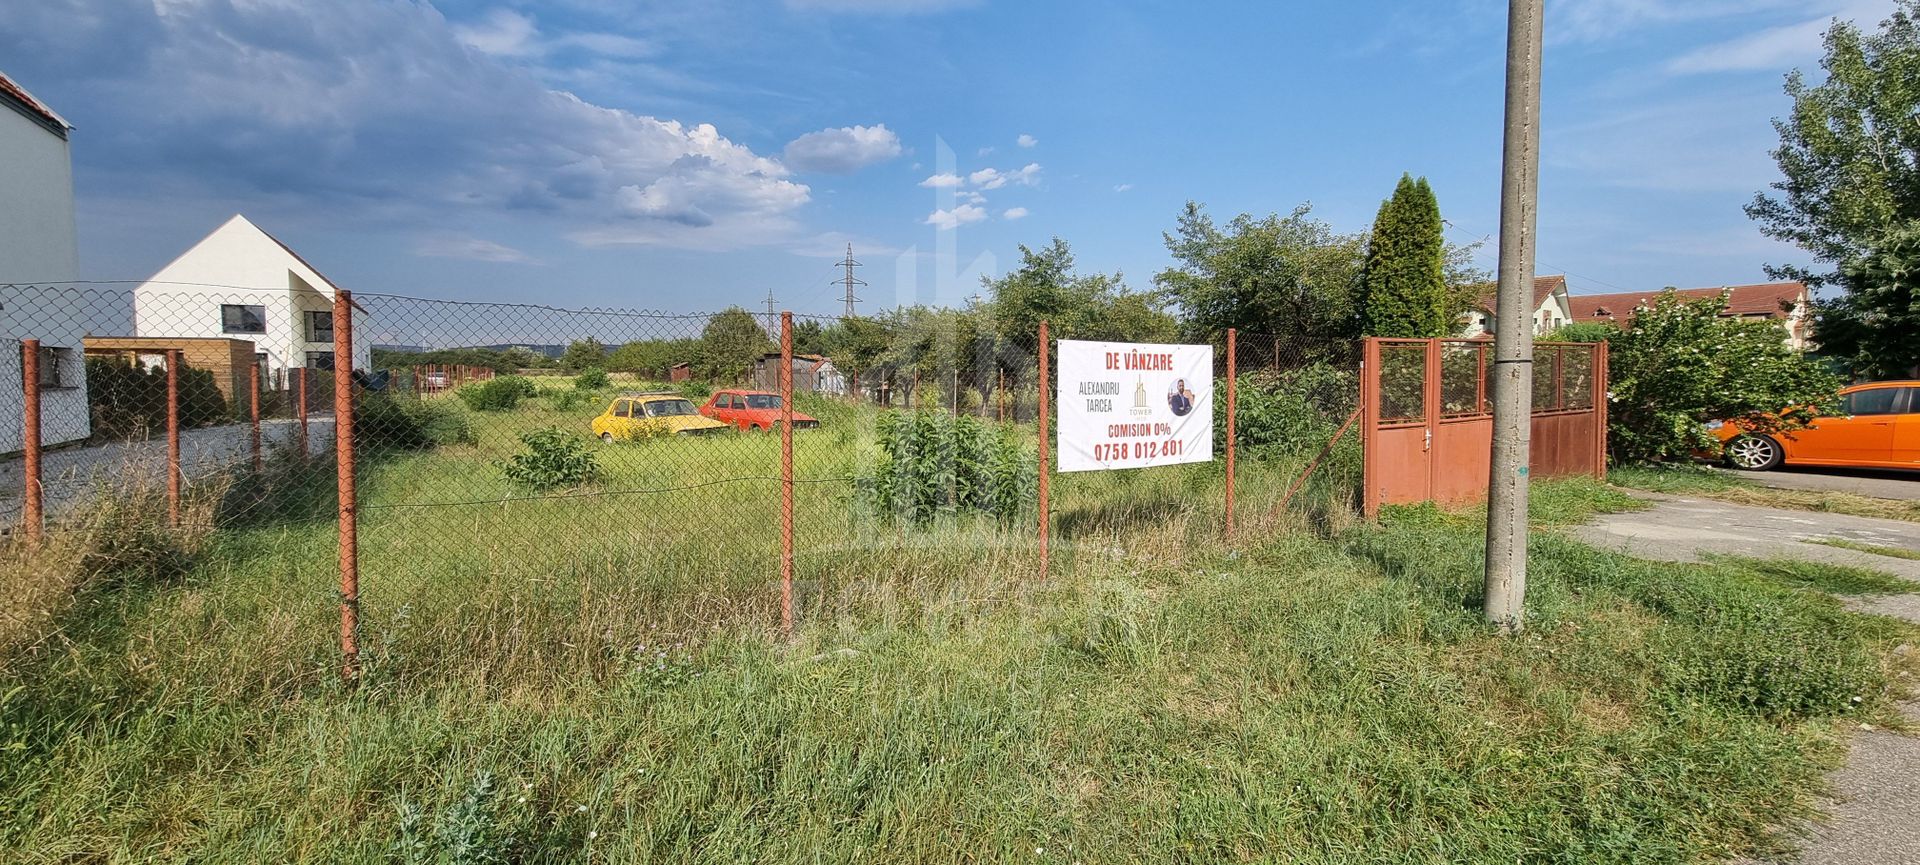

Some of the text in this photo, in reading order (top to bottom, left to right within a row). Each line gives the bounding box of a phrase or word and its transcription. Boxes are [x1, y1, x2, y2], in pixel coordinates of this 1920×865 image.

[1105, 348, 1173, 371] DE VÂNZARE
[1078, 381, 1120, 396] ALEXANDRU
[1086, 398, 1112, 413] TARCEA
[1129, 408, 1152, 416] TOWER
[1108, 422, 1171, 438] COMISION 0%
[1094, 443, 1128, 461] 0758
[1135, 442, 1157, 459] 012
